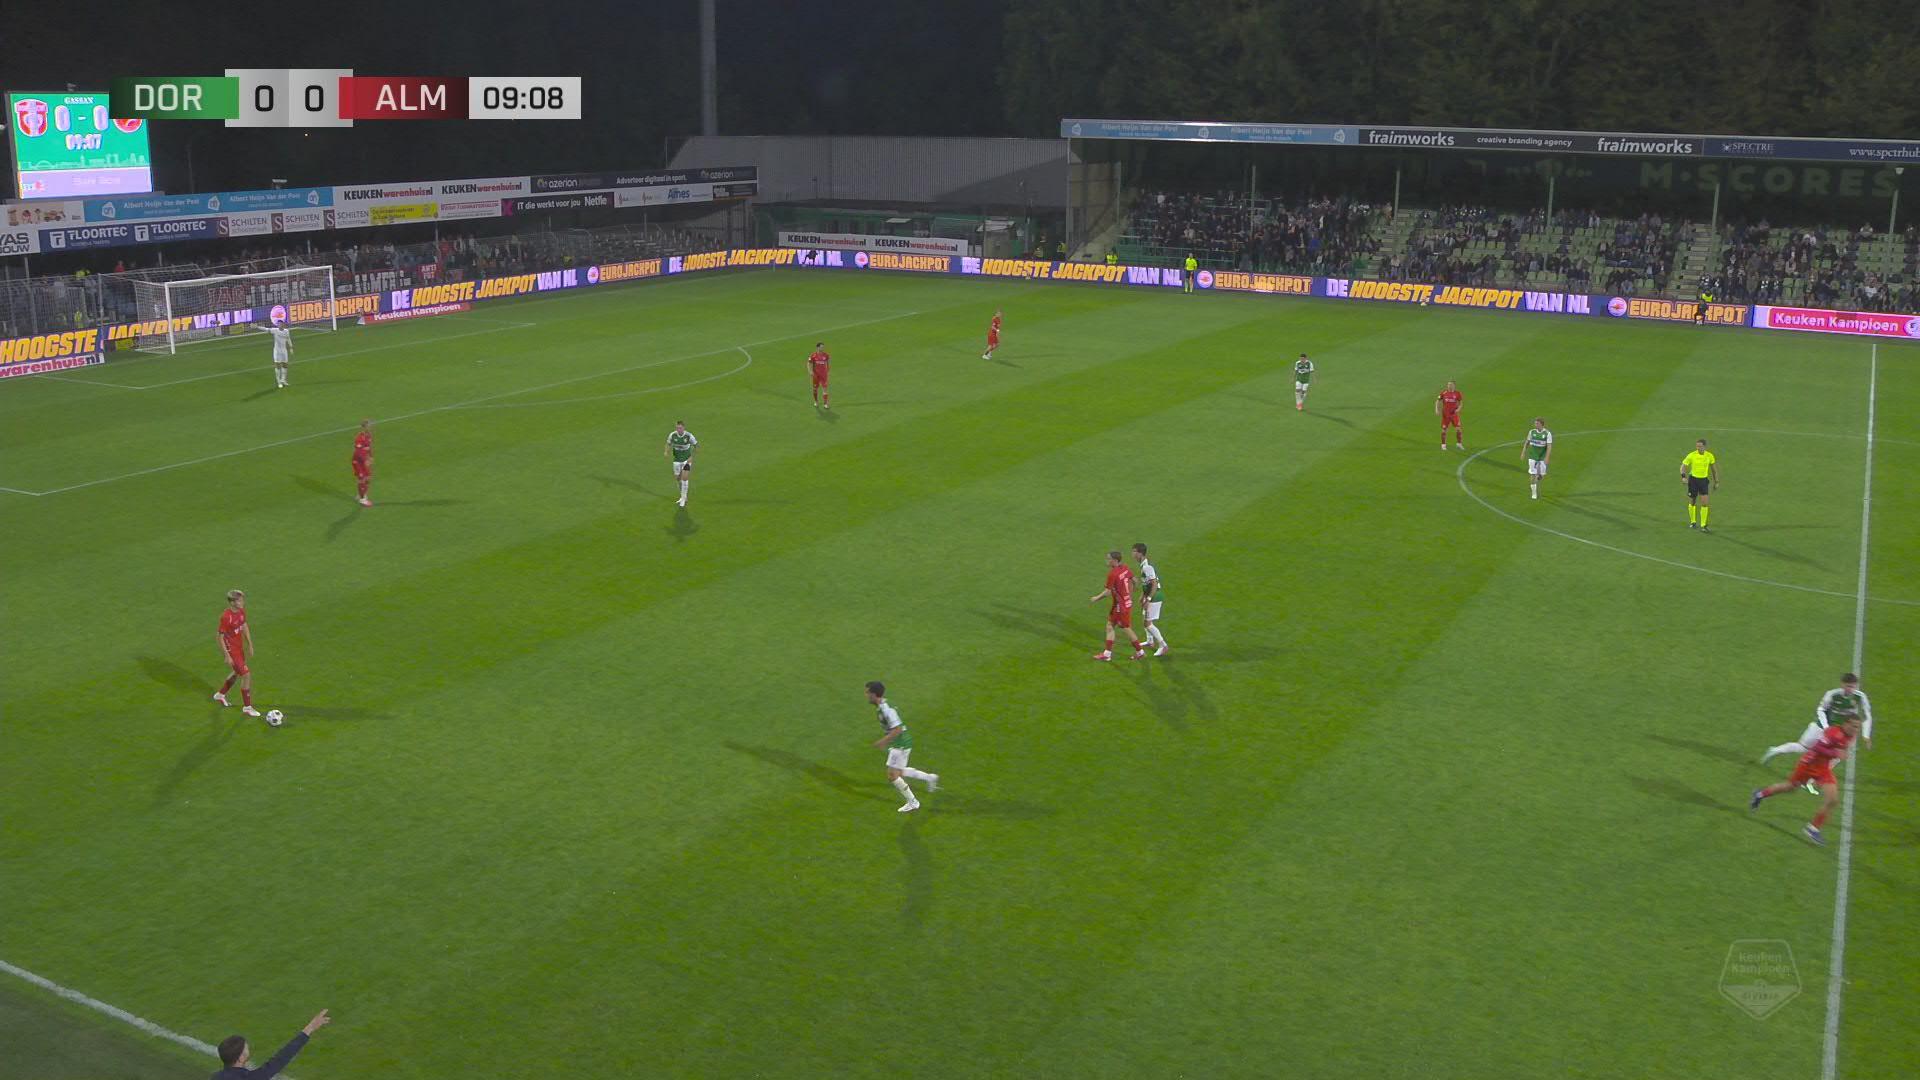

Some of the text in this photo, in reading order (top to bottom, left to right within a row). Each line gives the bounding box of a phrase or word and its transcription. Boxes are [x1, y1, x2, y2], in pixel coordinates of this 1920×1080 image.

[1369, 131, 1454, 146] fraimworks
[1477, 136, 1573, 148] creative branding agency
[1597, 137, 1693, 154] fraimworks
[525, 201, 536, 209] die
[286, 213, 320, 223] SCHILTEN
[0, 245, 30, 254] OUW
[600, 259, 661, 281] EUROJACKPOT
[669, 256, 682, 273] DE
[728, 248, 796, 265] JACKPOT
[826, 250, 843, 266] NL
[869, 253, 950, 272] EUROJACKPOT
[961, 256, 1182, 287] DE HOOGSTE JACKPOT VAN NL
[391, 290, 410, 310] DE
[411, 282, 474, 307] HOOGSTE
[475, 274, 536, 299] JACKPOT
[537, 271, 562, 291] VAN
[563, 269, 578, 287] NL
[1214, 273, 1312, 293] EUROJACKPOT
[1326, 278, 1590, 314] DE HOOGSTE JACKPOT VAN NL
[373, 303, 461, 322] Keuken Kampioen
[1775, 312, 1899, 333] Keuken Kampioen
[0, 329, 98, 364] HOOGSTE
